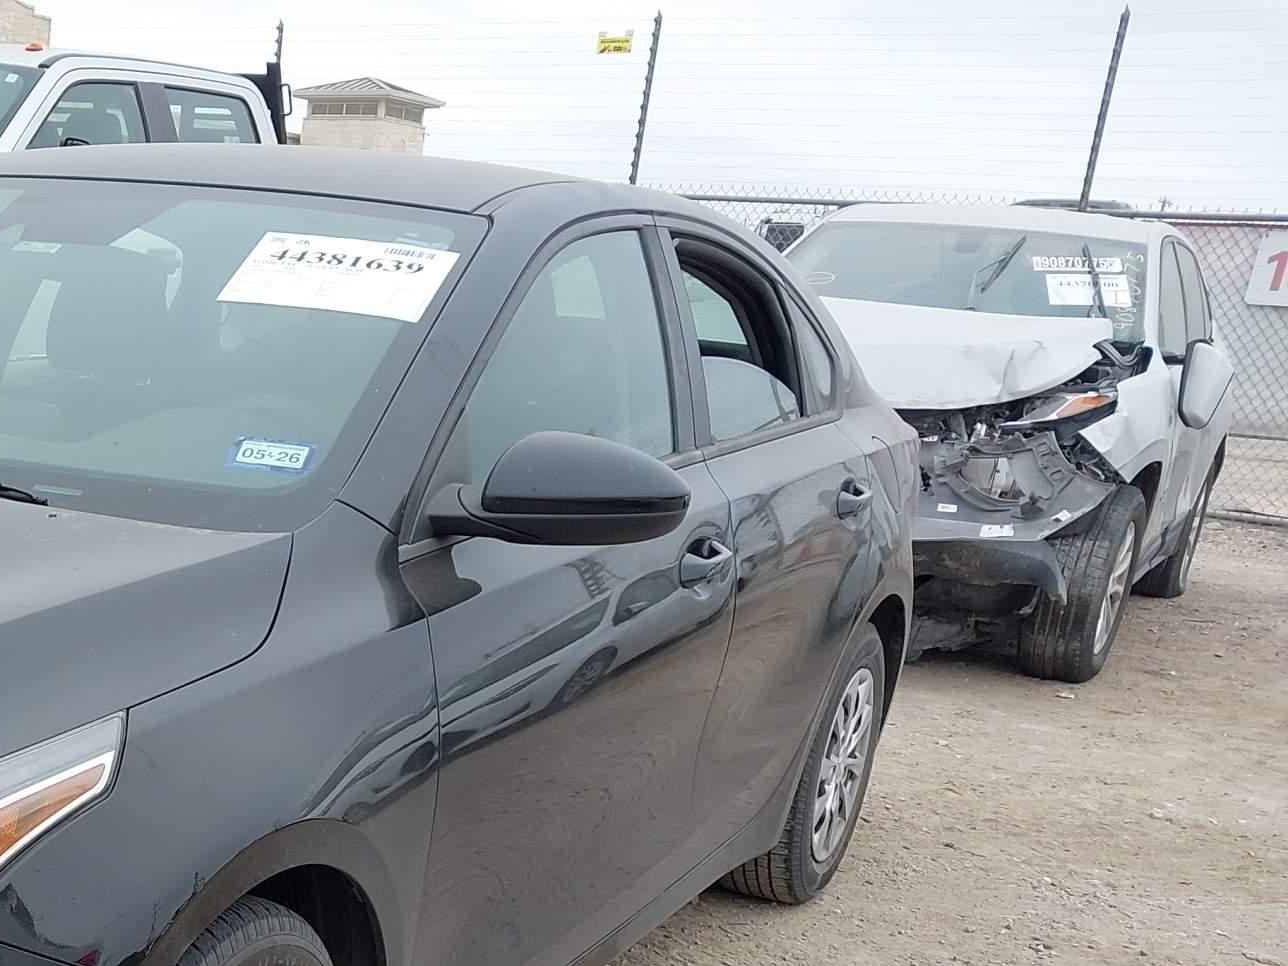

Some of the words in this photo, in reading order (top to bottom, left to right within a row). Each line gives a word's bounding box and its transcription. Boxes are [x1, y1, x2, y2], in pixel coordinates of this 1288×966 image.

[270, 249, 424, 274] 44381639
[241, 447, 267, 460] 05
[275, 451, 302, 464] 26
